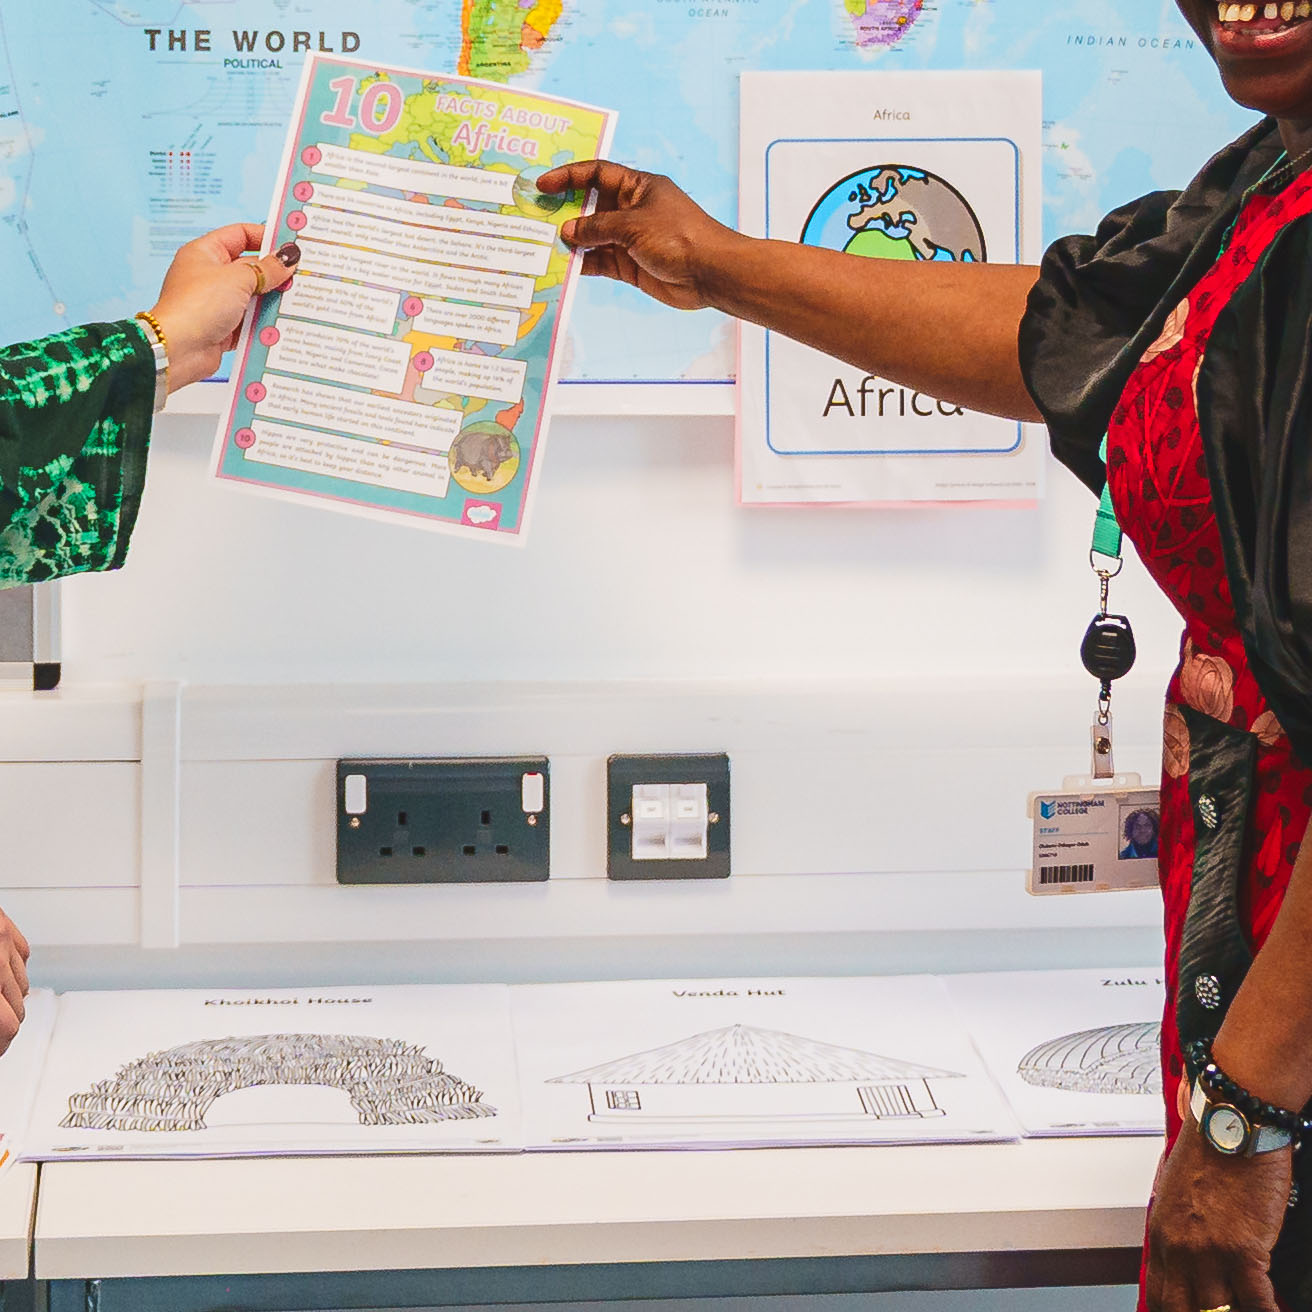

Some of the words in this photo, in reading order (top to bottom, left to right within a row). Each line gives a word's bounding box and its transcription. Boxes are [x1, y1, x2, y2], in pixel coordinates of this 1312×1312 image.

[687, 8, 730, 18] OCEAN
[144, 29, 213, 52] THE
[233, 30, 362, 53] WORLD
[1067, 35, 1127, 47] INDIAN
[1138, 37, 1195, 49] OCEAN
[223, 57, 284, 70] POLITICAL
[320, 76, 403, 134] 10
[435, 96, 496, 122] FACTS
[501, 105, 572, 134] ABOUT
[872, 108, 911, 122] Africa
[452, 123, 539, 159] Africa
[1056, 799, 1106, 809] NOTTINGHAM
[1056, 807, 1089, 816] COLLEGE
[1099, 978, 1147, 986] Zulu
[672, 989, 739, 997] Venda
[204, 997, 299, 1006] Khoikhoi
[308, 997, 373, 1005] House
